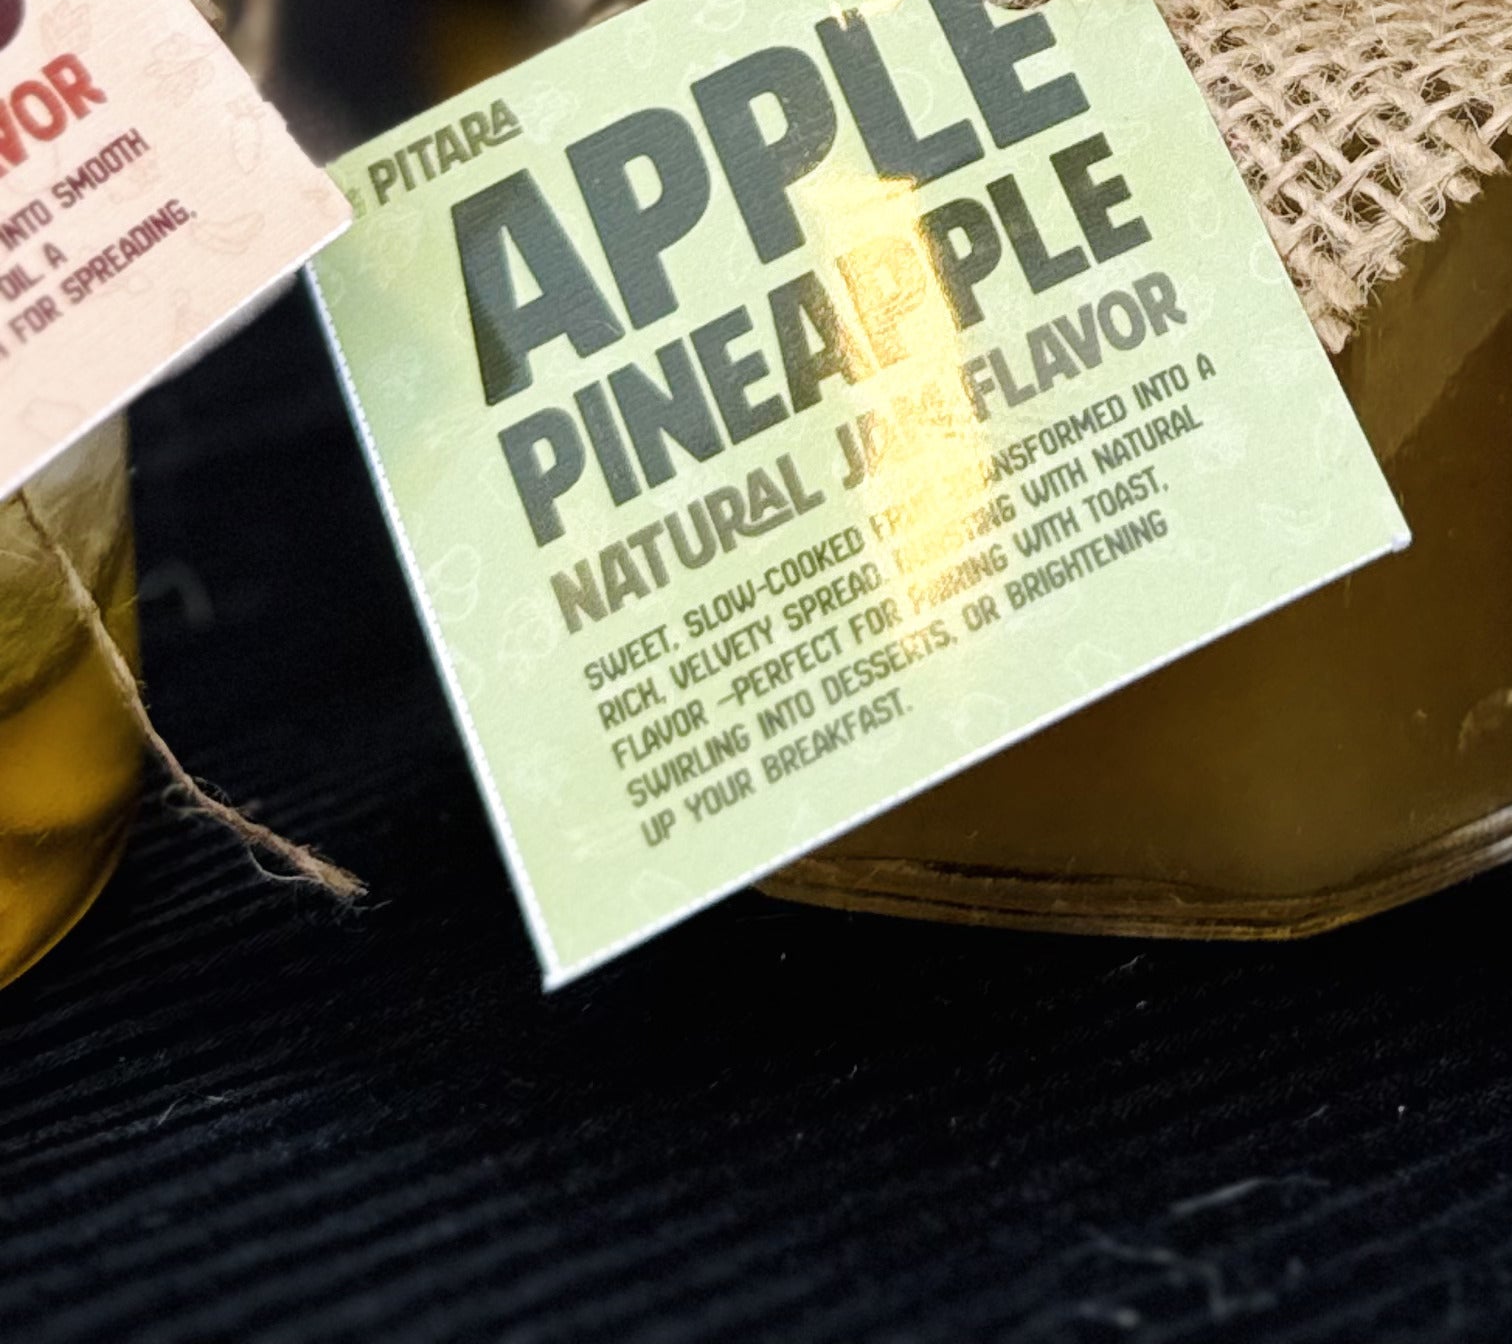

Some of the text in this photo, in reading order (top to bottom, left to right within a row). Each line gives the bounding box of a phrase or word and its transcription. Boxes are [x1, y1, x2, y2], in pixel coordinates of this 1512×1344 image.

[0, 127, 151, 251] INTO SMOOTH
[43, 242, 68, 269] A
[367, 99, 522, 207] PITARA
[8, 199, 198, 344] FOR SPREADING.
[549, 453, 826, 635] NATURAL
[961, 271, 1188, 424] FLAVOR
[583, 623, 680, 692] SWEET,
[682, 526, 865, 639] SLOW-COOKED
[1131, 363, 1190, 411] INTO
[1196, 352, 1217, 381] A
[597, 677, 667, 731] RICH,
[668, 614, 774, 691] VELVETY
[1020, 457, 1089, 508] WITH
[1091, 404, 1204, 475] NATURAL
[611, 698, 709, 769] FLAVOR
[847, 598, 902, 646] FOR
[1012, 506, 1081, 558] WITH
[1081, 464, 1169, 524] TOAST,
[626, 723, 751, 809] SWIRLING
[756, 689, 816, 741] INTO
[961, 595, 1002, 633] OR
[1004, 509, 1169, 611] BRIGHTENING
[640, 687, 913, 848] UP YOUR BREAKFAST.
